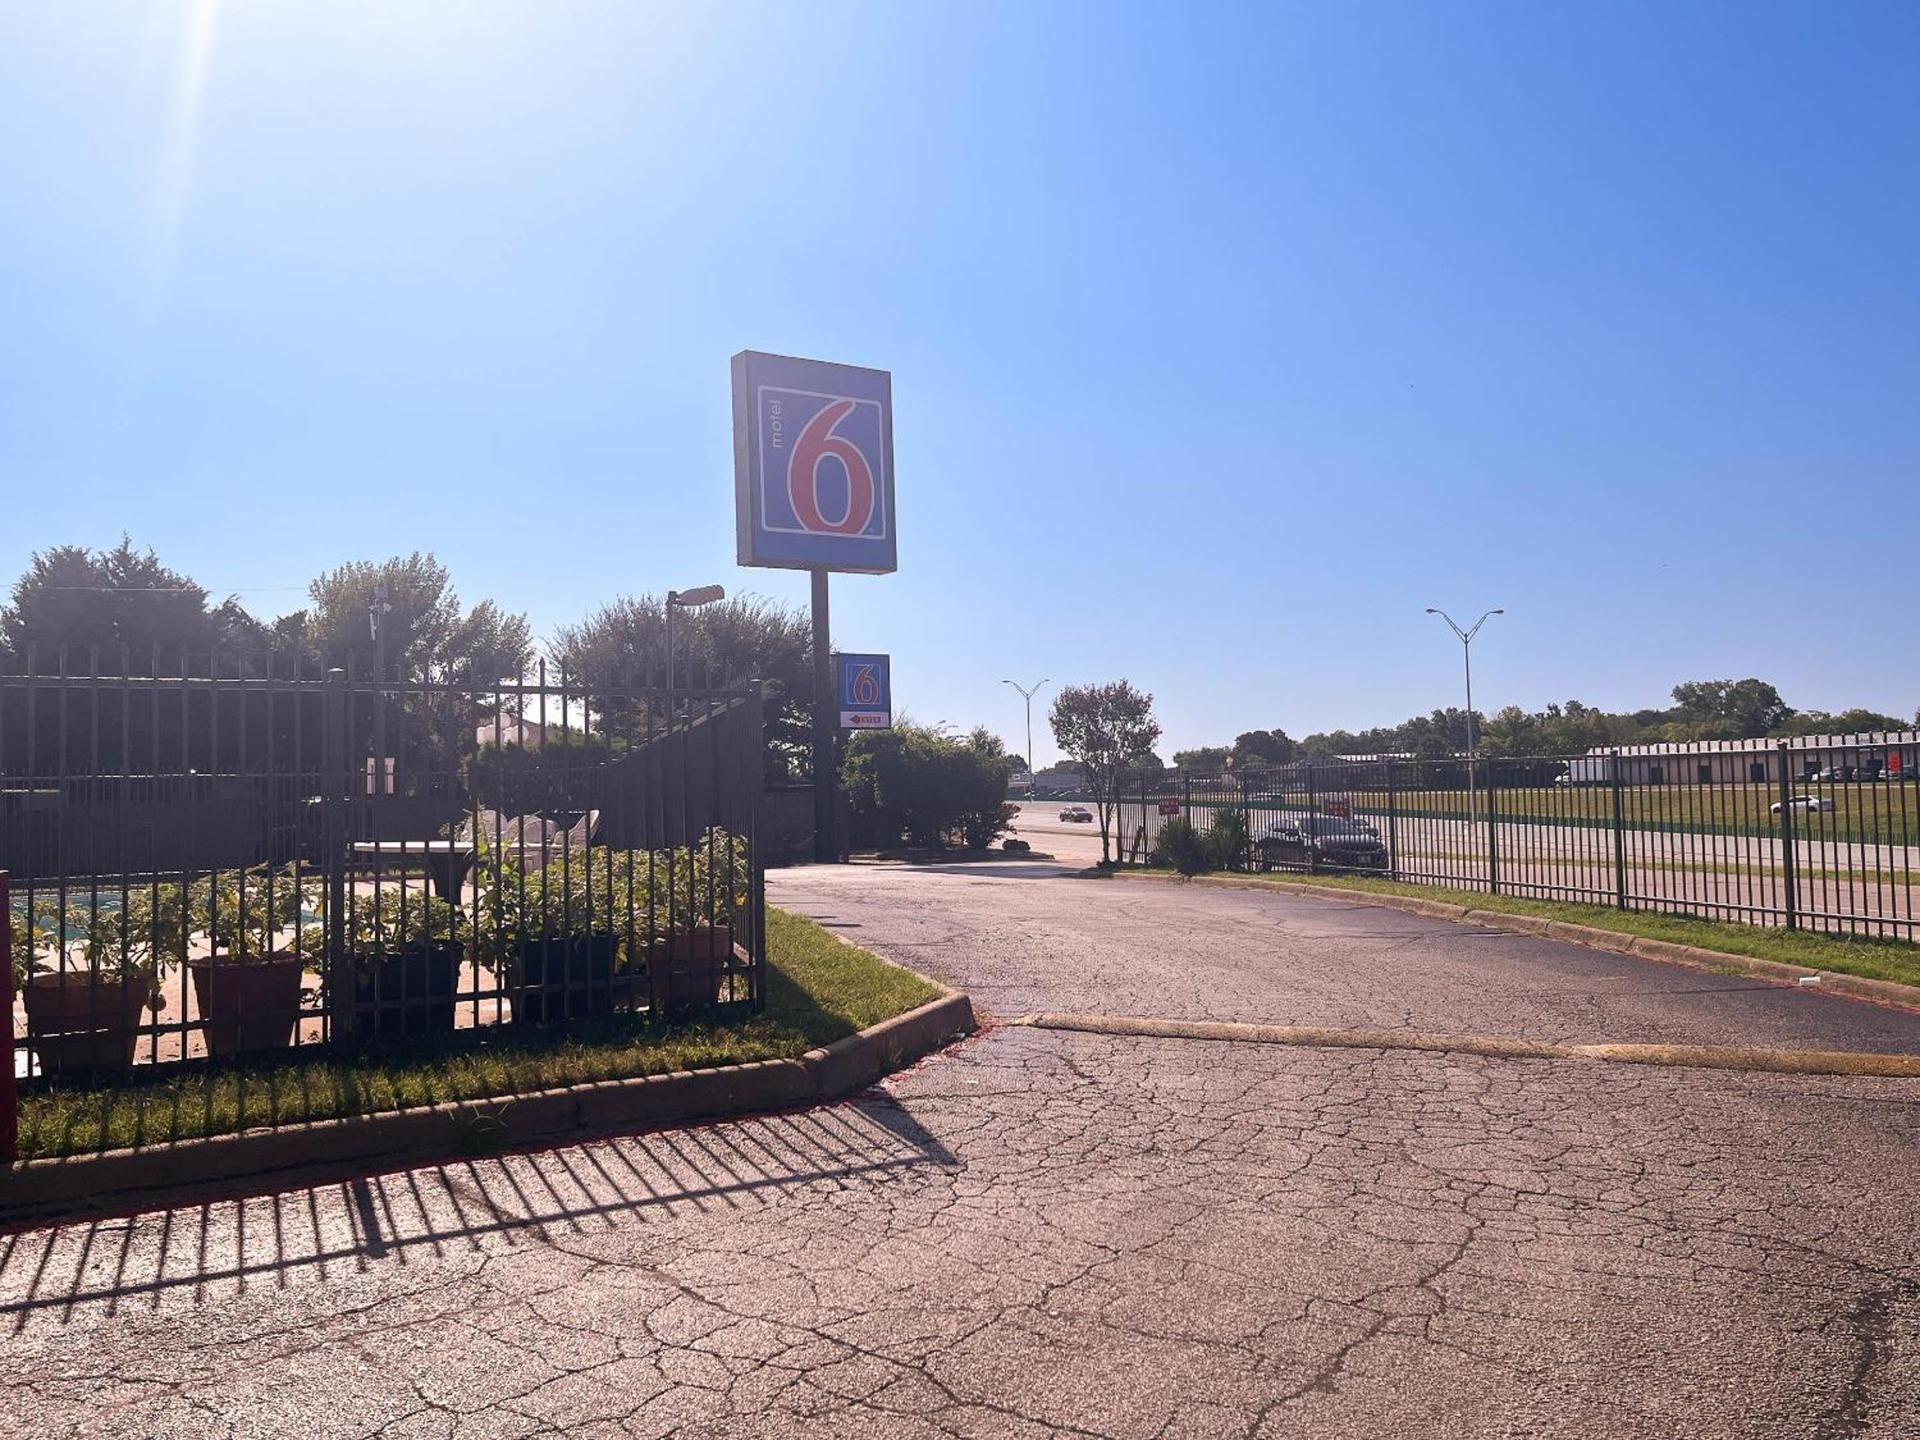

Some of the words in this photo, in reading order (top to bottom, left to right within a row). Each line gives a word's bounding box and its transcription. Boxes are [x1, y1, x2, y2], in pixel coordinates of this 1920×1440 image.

[769, 400, 783, 447] motel
[787, 399, 875, 535] 6
[853, 664, 879, 704] 6
